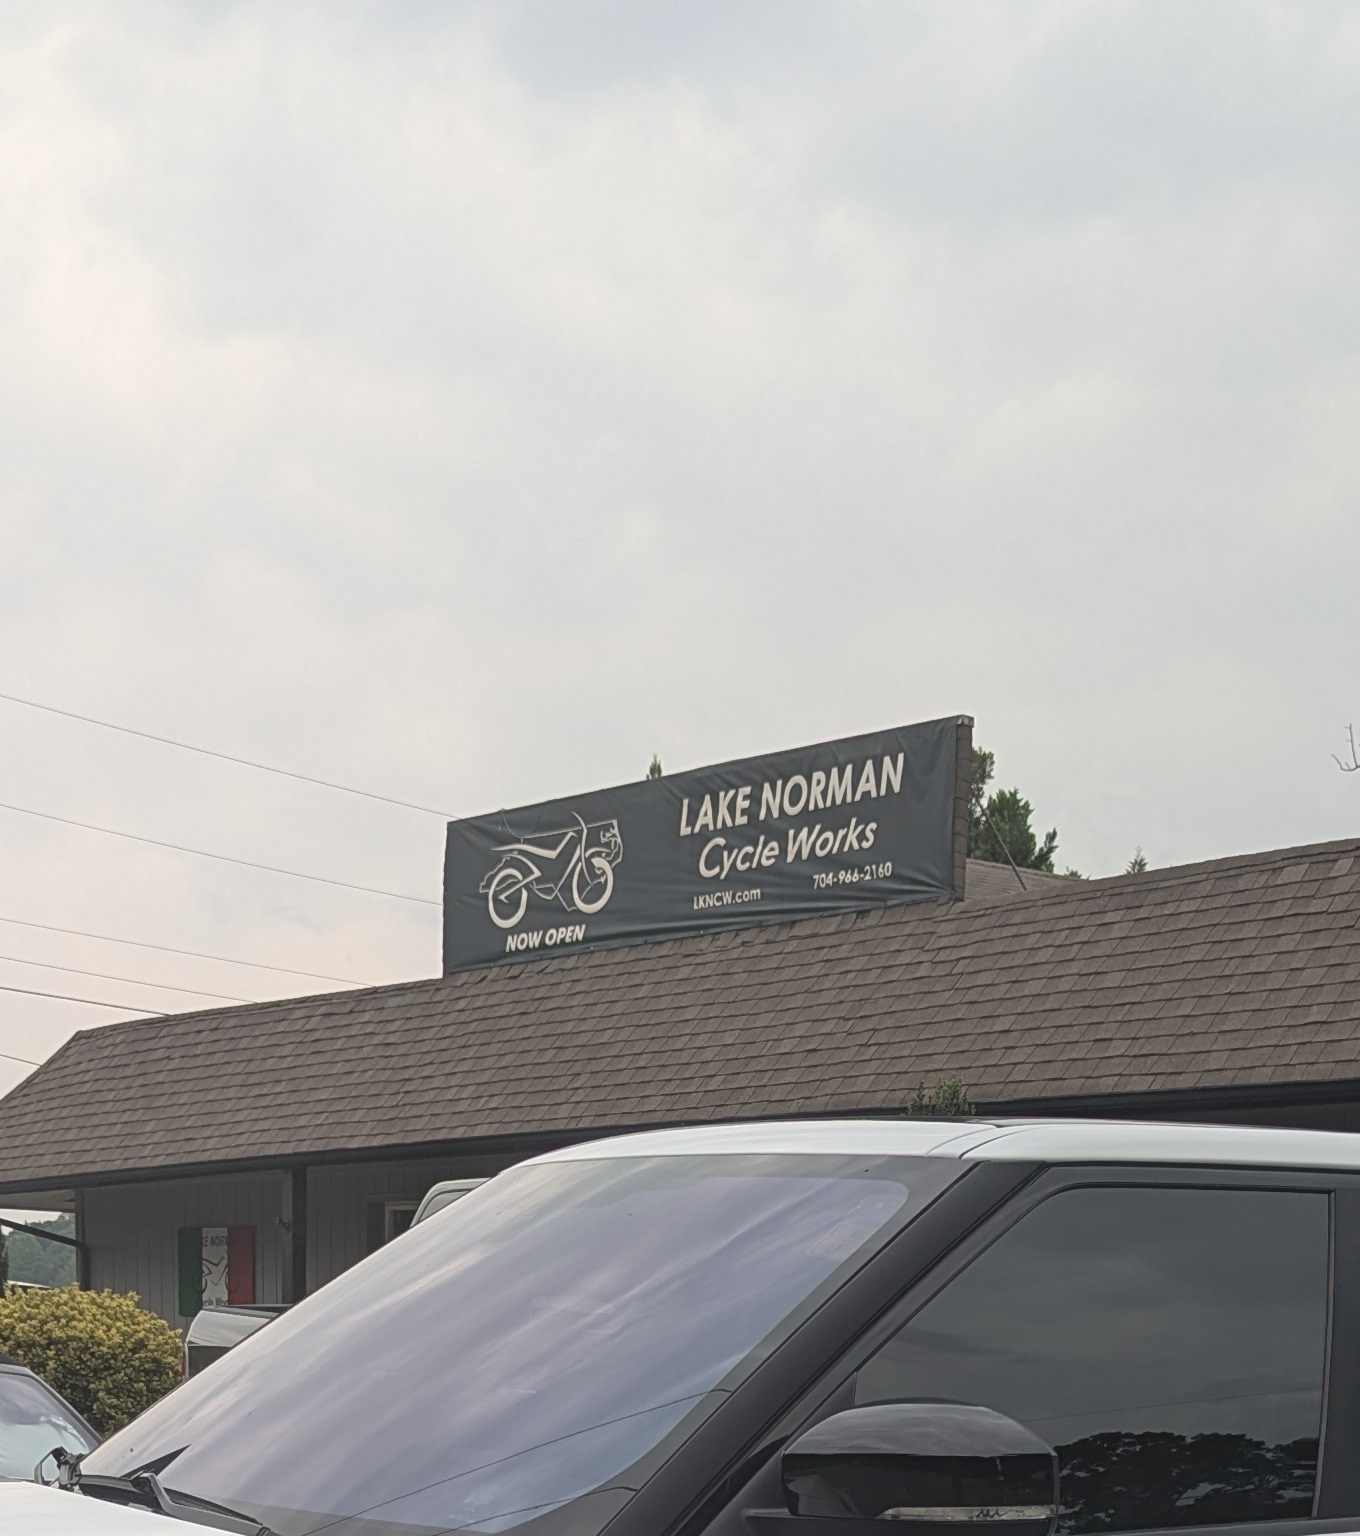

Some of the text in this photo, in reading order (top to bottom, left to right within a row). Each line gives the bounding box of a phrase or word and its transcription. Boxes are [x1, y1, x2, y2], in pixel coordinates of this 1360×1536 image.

[680, 752, 905, 836] LAKE NORMAN
[698, 817, 878, 881] Cycle Works
[812, 861, 893, 889] 704-966-2160
[693, 888, 761, 910] LKNCW.com
[505, 923, 586, 953] NOW OPEN
